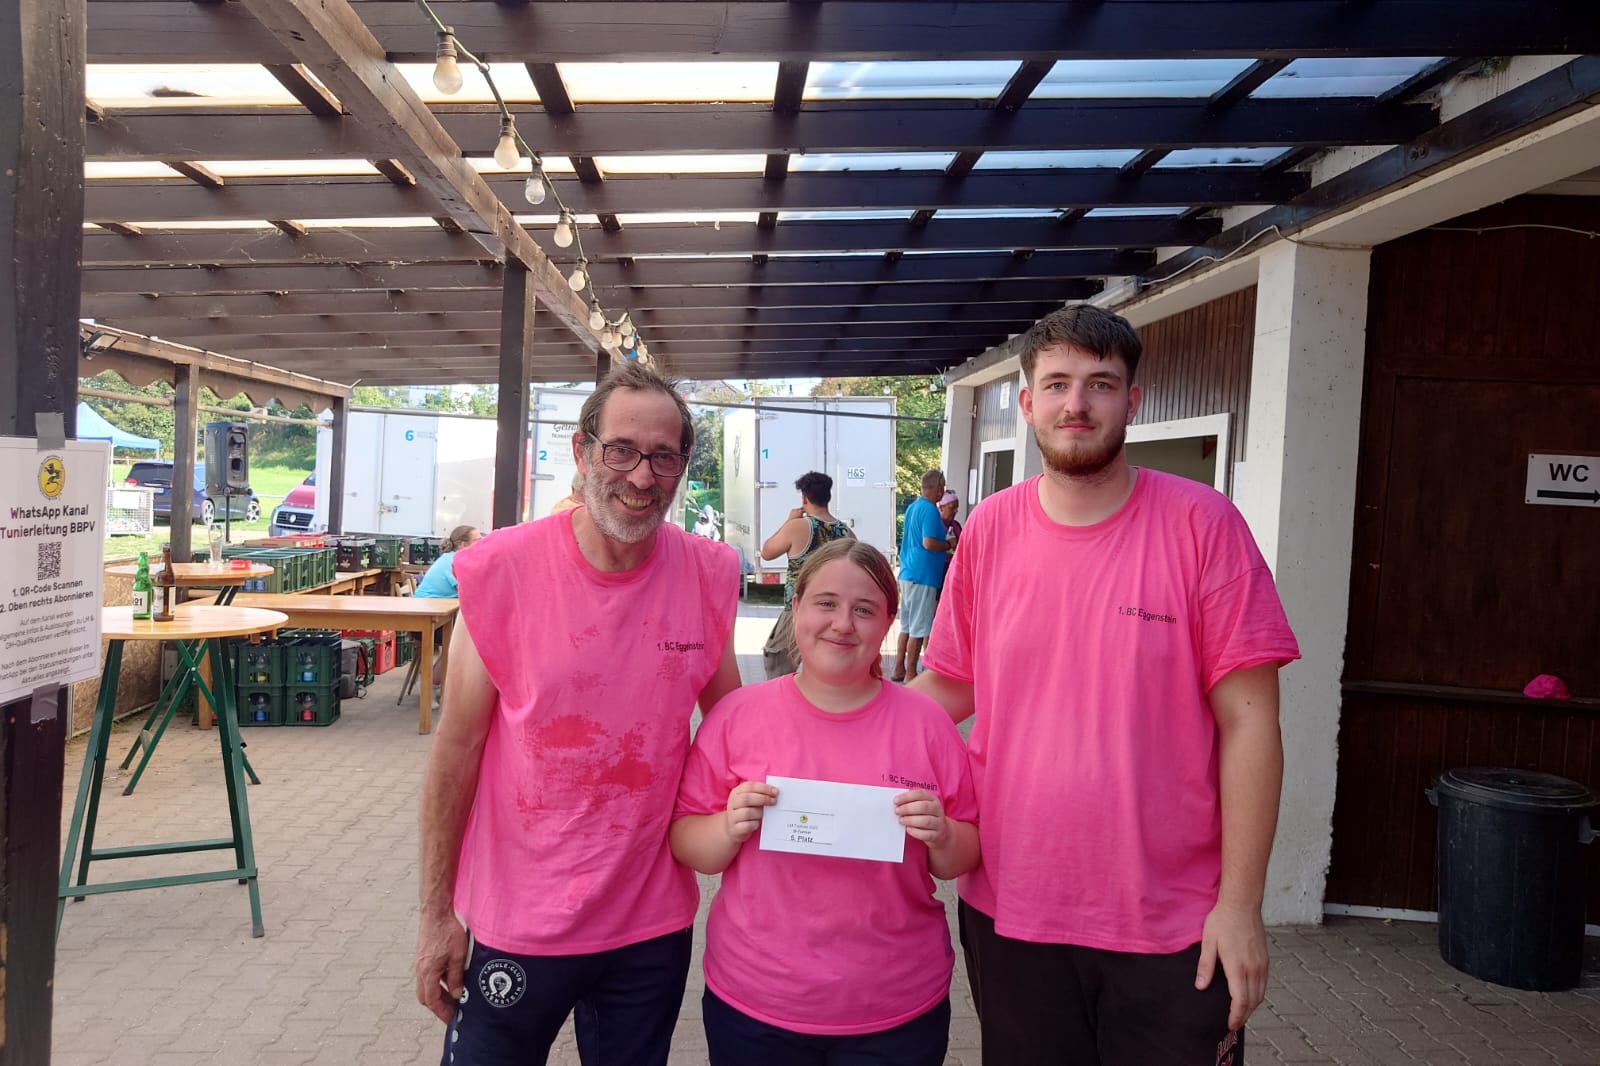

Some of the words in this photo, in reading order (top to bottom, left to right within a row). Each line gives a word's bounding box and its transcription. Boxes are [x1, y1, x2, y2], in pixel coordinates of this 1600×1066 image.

[405, 430, 414, 441] 6
[539, 450, 548, 461] 2
[762, 449, 769, 459] 1
[847, 468, 865, 478] H&S
[1549, 463, 1589, 482] WC
[10, 506, 61, 520] WhatsApp
[63, 505, 89, 516] Kanal
[0, 524, 67, 539] Tunierleitung
[70, 520, 95, 533] BBPV
[12, 588, 19, 597] 1.
[20, 584, 51, 596] QR-Code
[53, 580, 83, 591] Scannen
[0, 603, 7, 614] 2.
[8, 602, 27, 612] Oben
[29, 597, 53, 608] rechts
[54, 590, 93, 604] Abonnieren
[1126, 607, 1136, 616] BC
[1138, 608, 1177, 624] Eggenstein
[664, 641, 675, 651] BC
[889, 774, 899, 784] BC
[900, 777, 938, 791] Eggenstein
[797, 835, 813, 843] Platz
